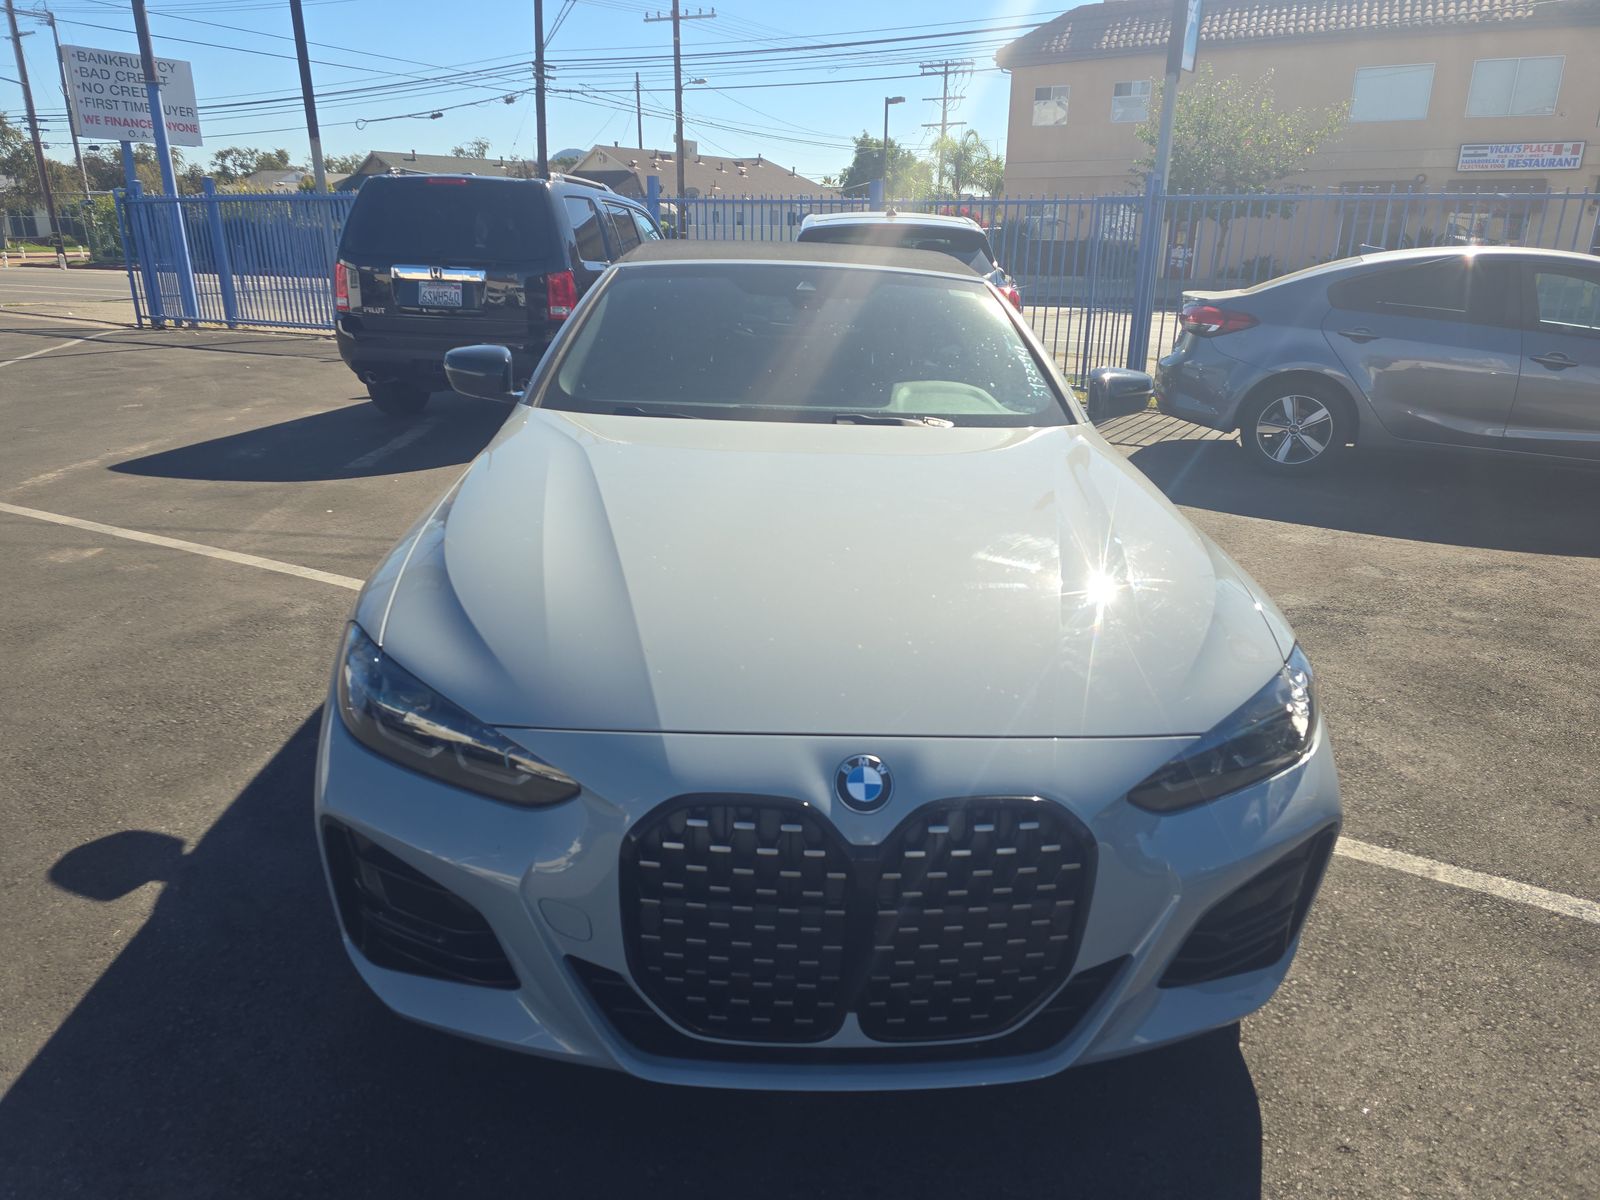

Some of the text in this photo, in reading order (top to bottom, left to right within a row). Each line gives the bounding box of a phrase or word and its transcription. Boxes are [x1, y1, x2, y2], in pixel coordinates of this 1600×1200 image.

[77, 51, 176, 74] BANKRUCY
[79, 66, 168, 86] BAD CRET
[82, 82, 104, 94] NO
[84, 97, 194, 118] FIRST TIME UYER
[83, 114, 101, 125] WE
[104, 116, 153, 129] FINANCE
[166, 121, 198, 134] NYONE
[1488, 143, 1554, 154] VICKI'S PLACE
[1507, 157, 1580, 169] RESTAURANT
[363, 306, 386, 314] PILOT
[841, 757, 888, 775] BMW
